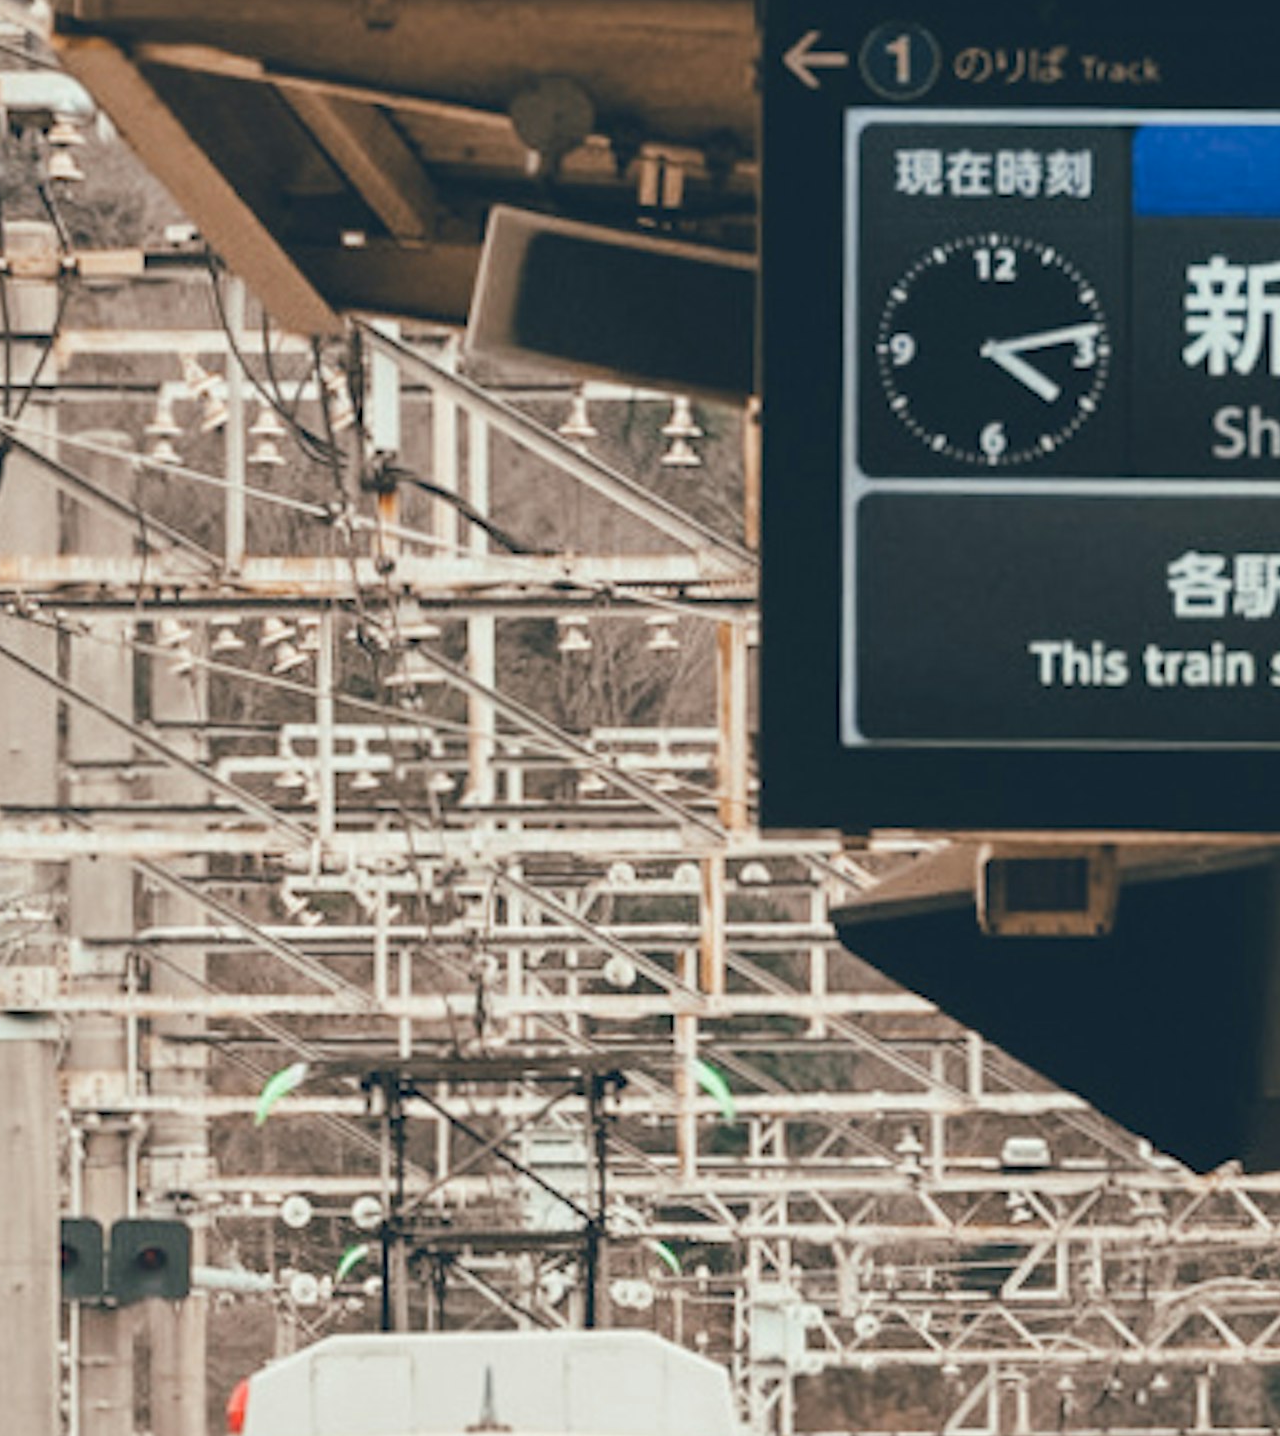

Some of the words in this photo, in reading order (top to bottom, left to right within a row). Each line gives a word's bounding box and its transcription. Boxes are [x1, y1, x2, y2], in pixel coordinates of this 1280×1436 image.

[885, 35, 912, 84] 1
[953, 46, 1069, 84] のりば
[1081, 57, 1161, 83] Track
[894, 148, 1093, 199] 現在時刻
[972, 248, 1018, 283] 12
[889, 334, 916, 365] 9
[1072, 333, 1097, 368] 3
[979, 421, 1007, 457] 6
[1028, 641, 1128, 687] This
[1143, 642, 1255, 688] train
